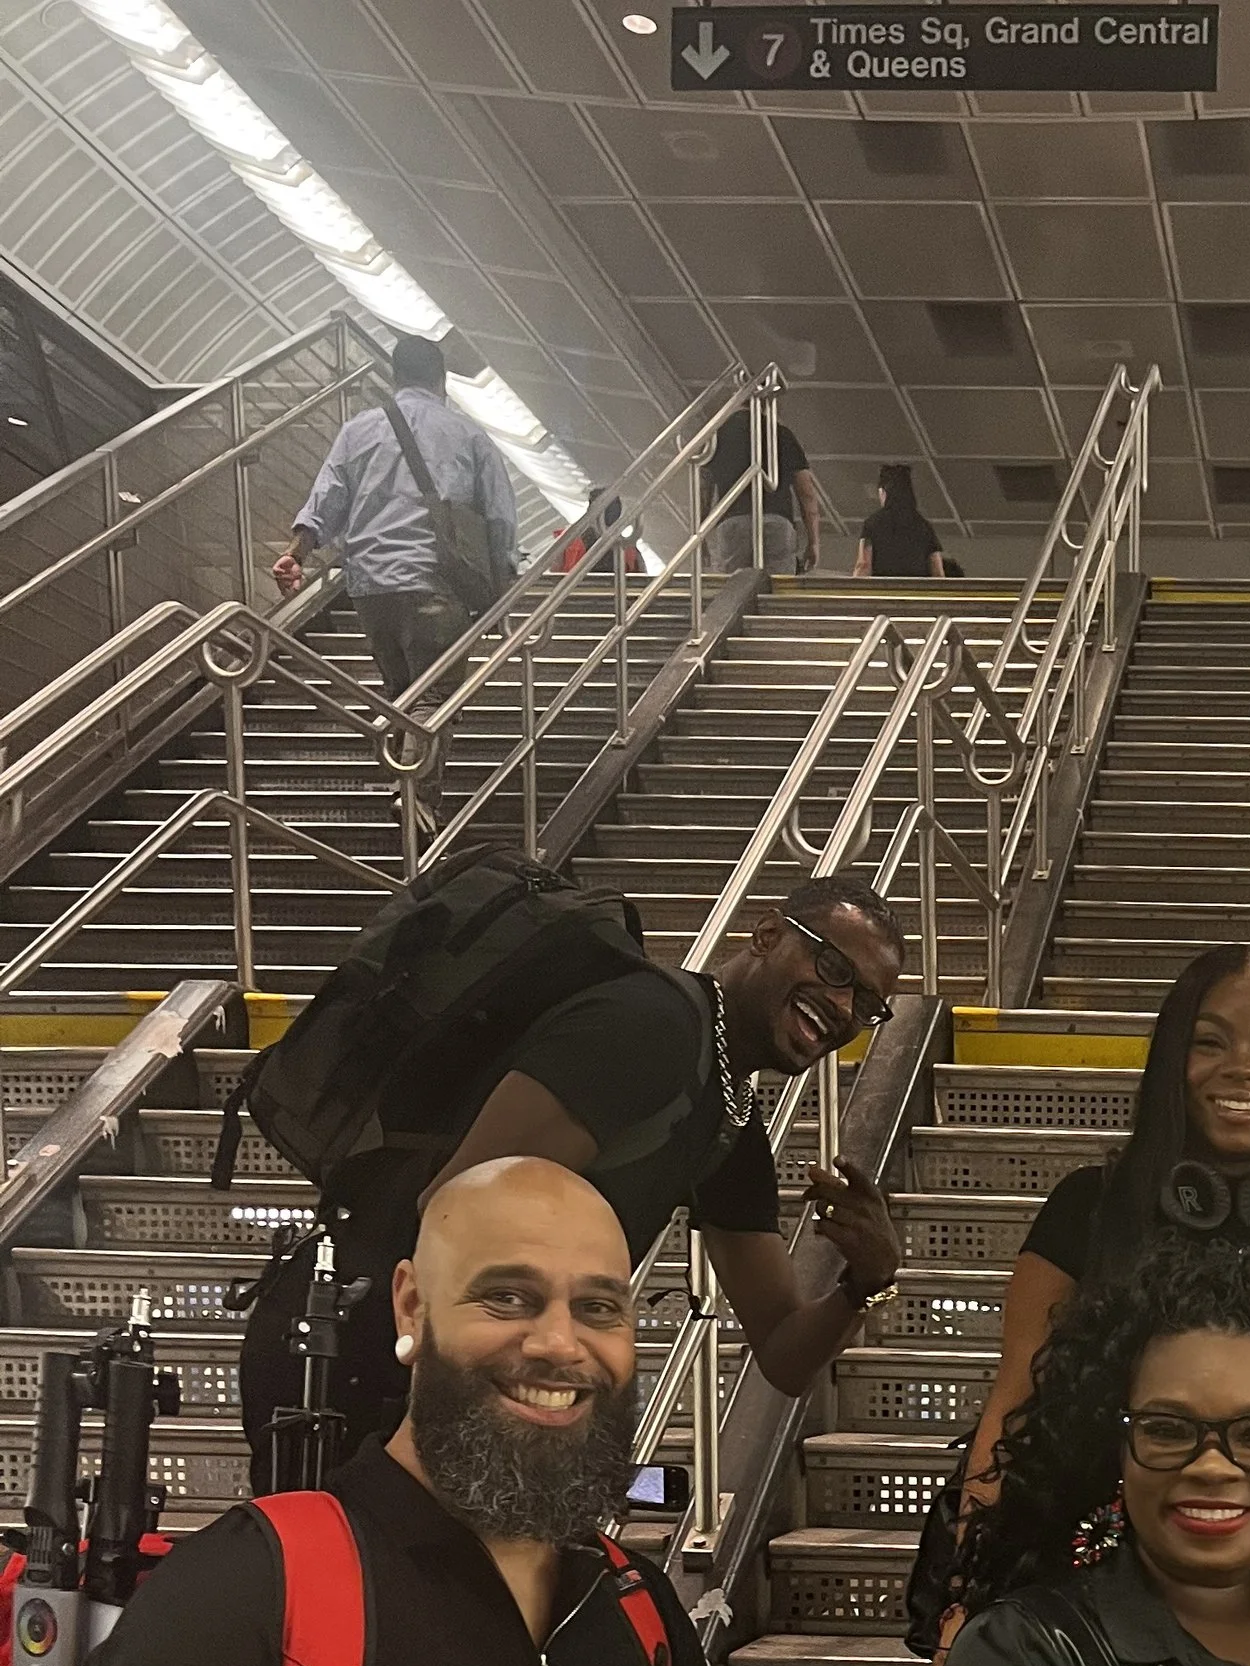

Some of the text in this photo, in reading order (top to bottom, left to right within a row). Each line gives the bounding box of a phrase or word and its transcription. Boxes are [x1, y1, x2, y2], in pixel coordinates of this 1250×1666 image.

[809, 16, 1209, 50] Times Sq, Grand Central
[762, 33, 784, 66] 7
[809, 49, 967, 78] & Queens
[1177, 1186, 1203, 1212] R
